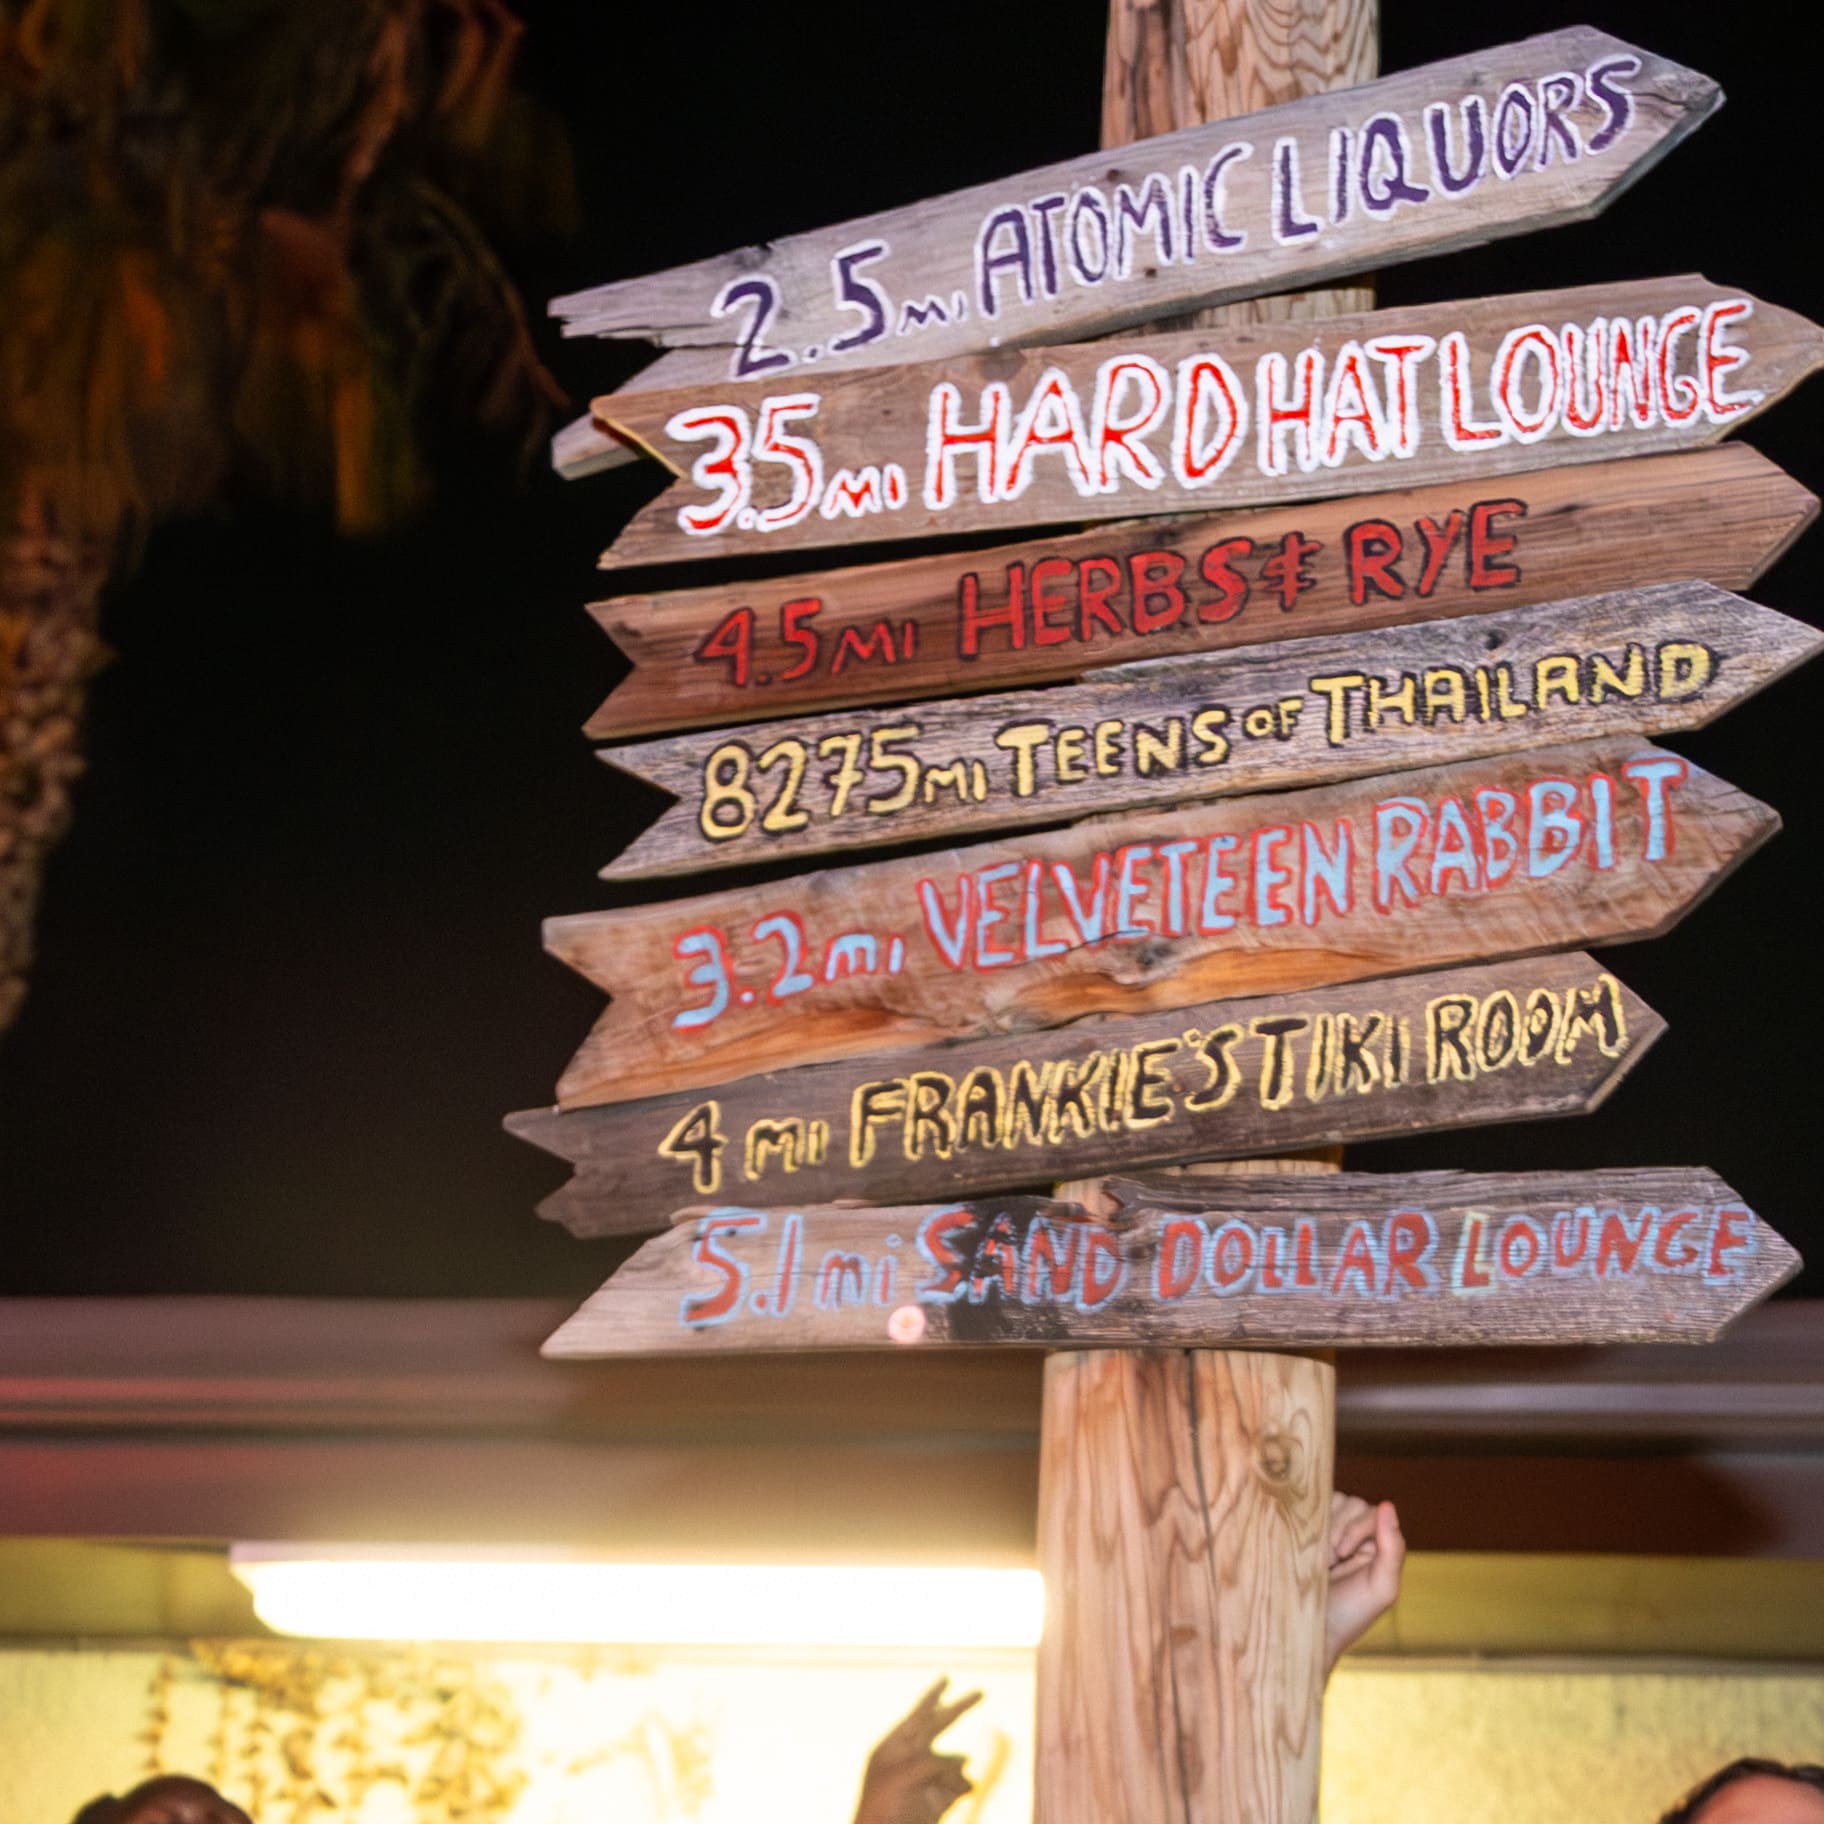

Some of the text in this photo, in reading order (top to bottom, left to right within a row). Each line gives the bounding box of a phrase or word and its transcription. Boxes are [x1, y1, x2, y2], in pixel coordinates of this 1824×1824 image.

[976, 142, 1253, 321] ATOMIC
[1272, 53, 1643, 245] LIQUORS
[923, 352, 1247, 510] HARD
[1256, 334, 1436, 477] HAT
[1438, 298, 1767, 453] LOUNGE
[959, 536, 1255, 661] HERBS
[1343, 498, 1528, 607] RYE
[994, 703, 1232, 799] TEENS
[1307, 639, 1720, 748] THAILAND
[916, 818, 1356, 974] VELVETEEN
[1372, 753, 1687, 917] RABBIT
[657, 1100, 729, 1195] 4
[849, 1023, 1244, 1169] FRANKIE'S
[1249, 1010, 1411, 1112] TIKI
[1424, 972, 1629, 1086] ROOM
[915, 1203, 1131, 1314] SAND
[1151, 1205, 1440, 1303] DOLLAR
[1449, 1203, 1759, 1299] LOUNGE
